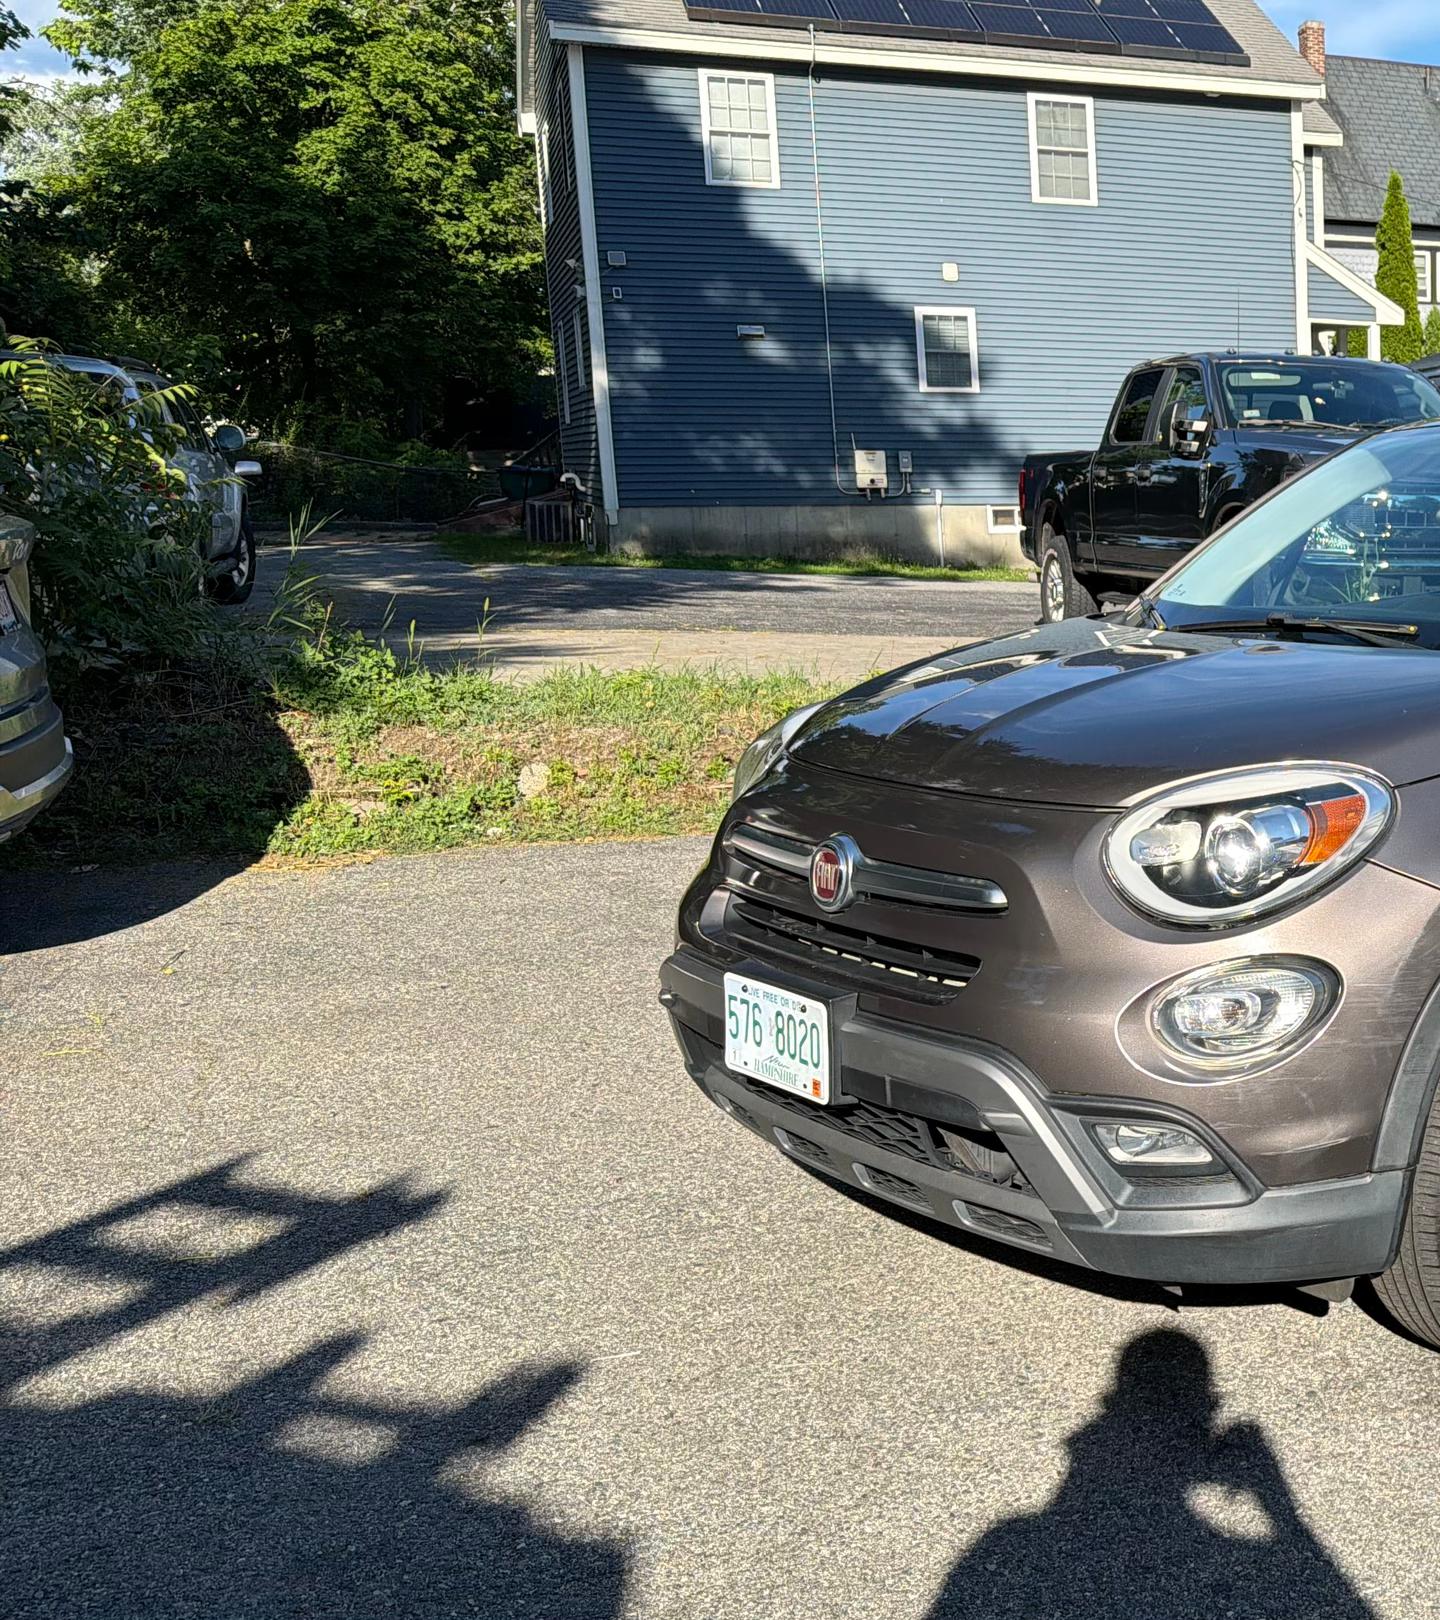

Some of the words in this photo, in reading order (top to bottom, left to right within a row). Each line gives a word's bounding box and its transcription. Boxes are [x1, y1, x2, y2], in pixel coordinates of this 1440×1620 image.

[816, 861, 838, 890] FIAT
[728, 994, 763, 1048] 576
[775, 1010, 821, 1069] 8020
[753, 1058, 800, 1087] HAMPSHIRE
